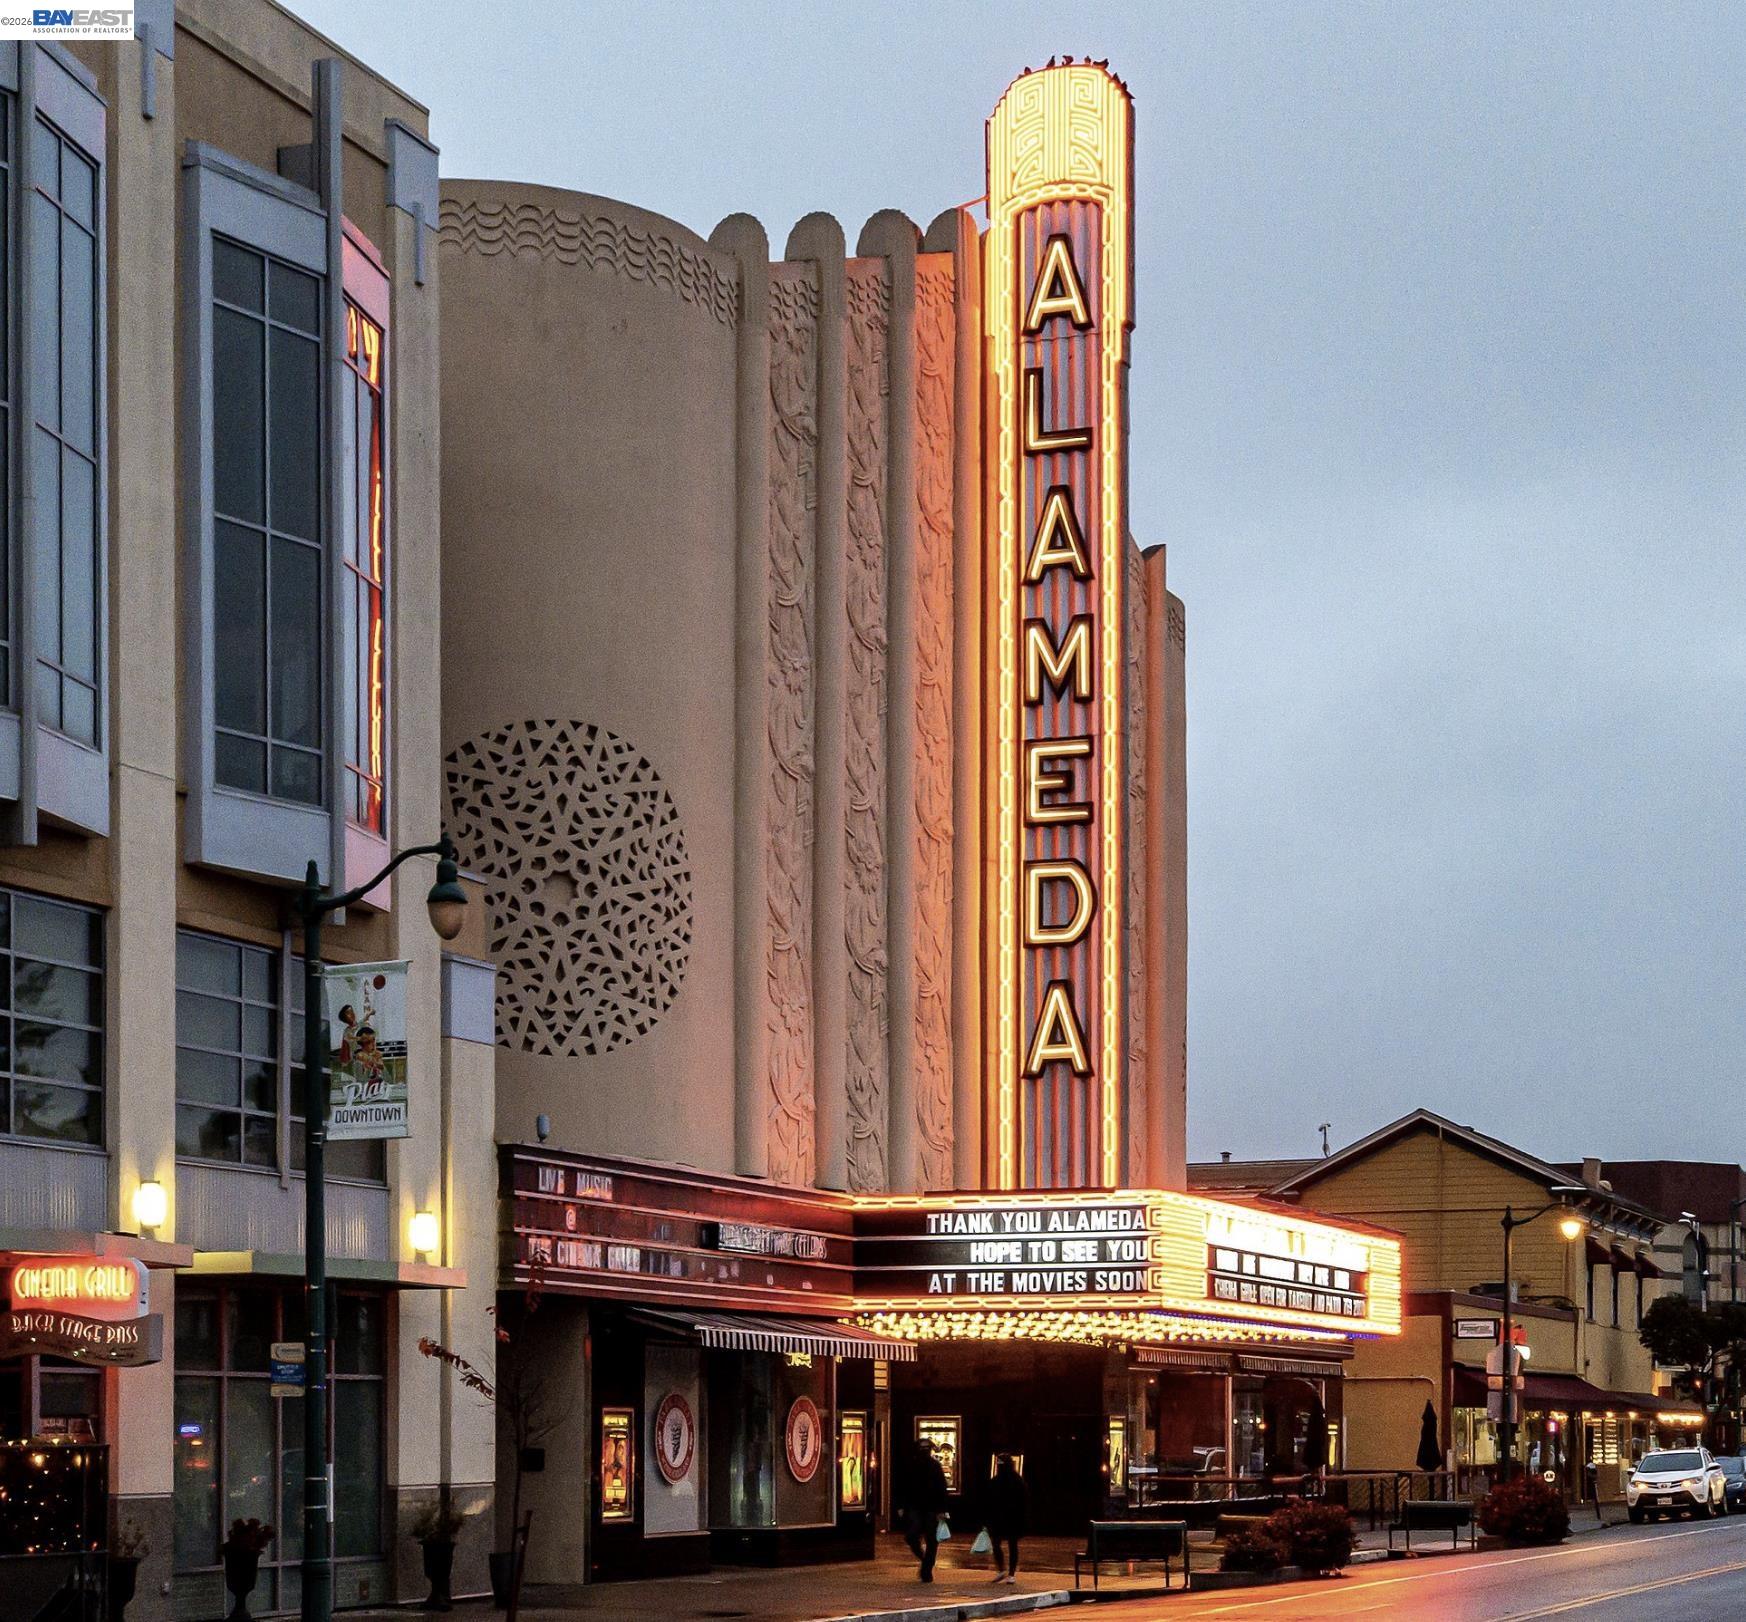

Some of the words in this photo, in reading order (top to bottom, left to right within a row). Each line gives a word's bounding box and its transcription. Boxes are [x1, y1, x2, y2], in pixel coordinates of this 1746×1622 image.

[1022, 233, 1098, 1078] ALAMEDA
[342, 1081, 393, 1107] Play
[335, 1107, 402, 1124] DOWNTOWN
[538, 1167, 565, 1195] LIVE
[576, 1172, 613, 1200] MUSIC
[927, 1213, 994, 1234] THANK
[1000, 1211, 1041, 1233] YOU
[1048, 1209, 1146, 1232] ALAMEDA
[970, 1241, 1022, 1263] HOPE
[1028, 1241, 1056, 1263] TO
[1061, 1240, 1098, 1262] SEE
[1105, 1239, 1148, 1261] YOU
[14, 1267, 79, 1299] CINEMA
[84, 1265, 133, 1298] GRILL
[928, 1273, 956, 1294] AT
[967, 1272, 1005, 1293] THE
[1012, 1271, 1087, 1292] MOVIES
[1095, 1270, 1148, 1291] SOON
[11, 1313, 54, 1333] BACK
[60, 1316, 103, 1343] STAGE
[106, 1325, 139, 1344] PASS
